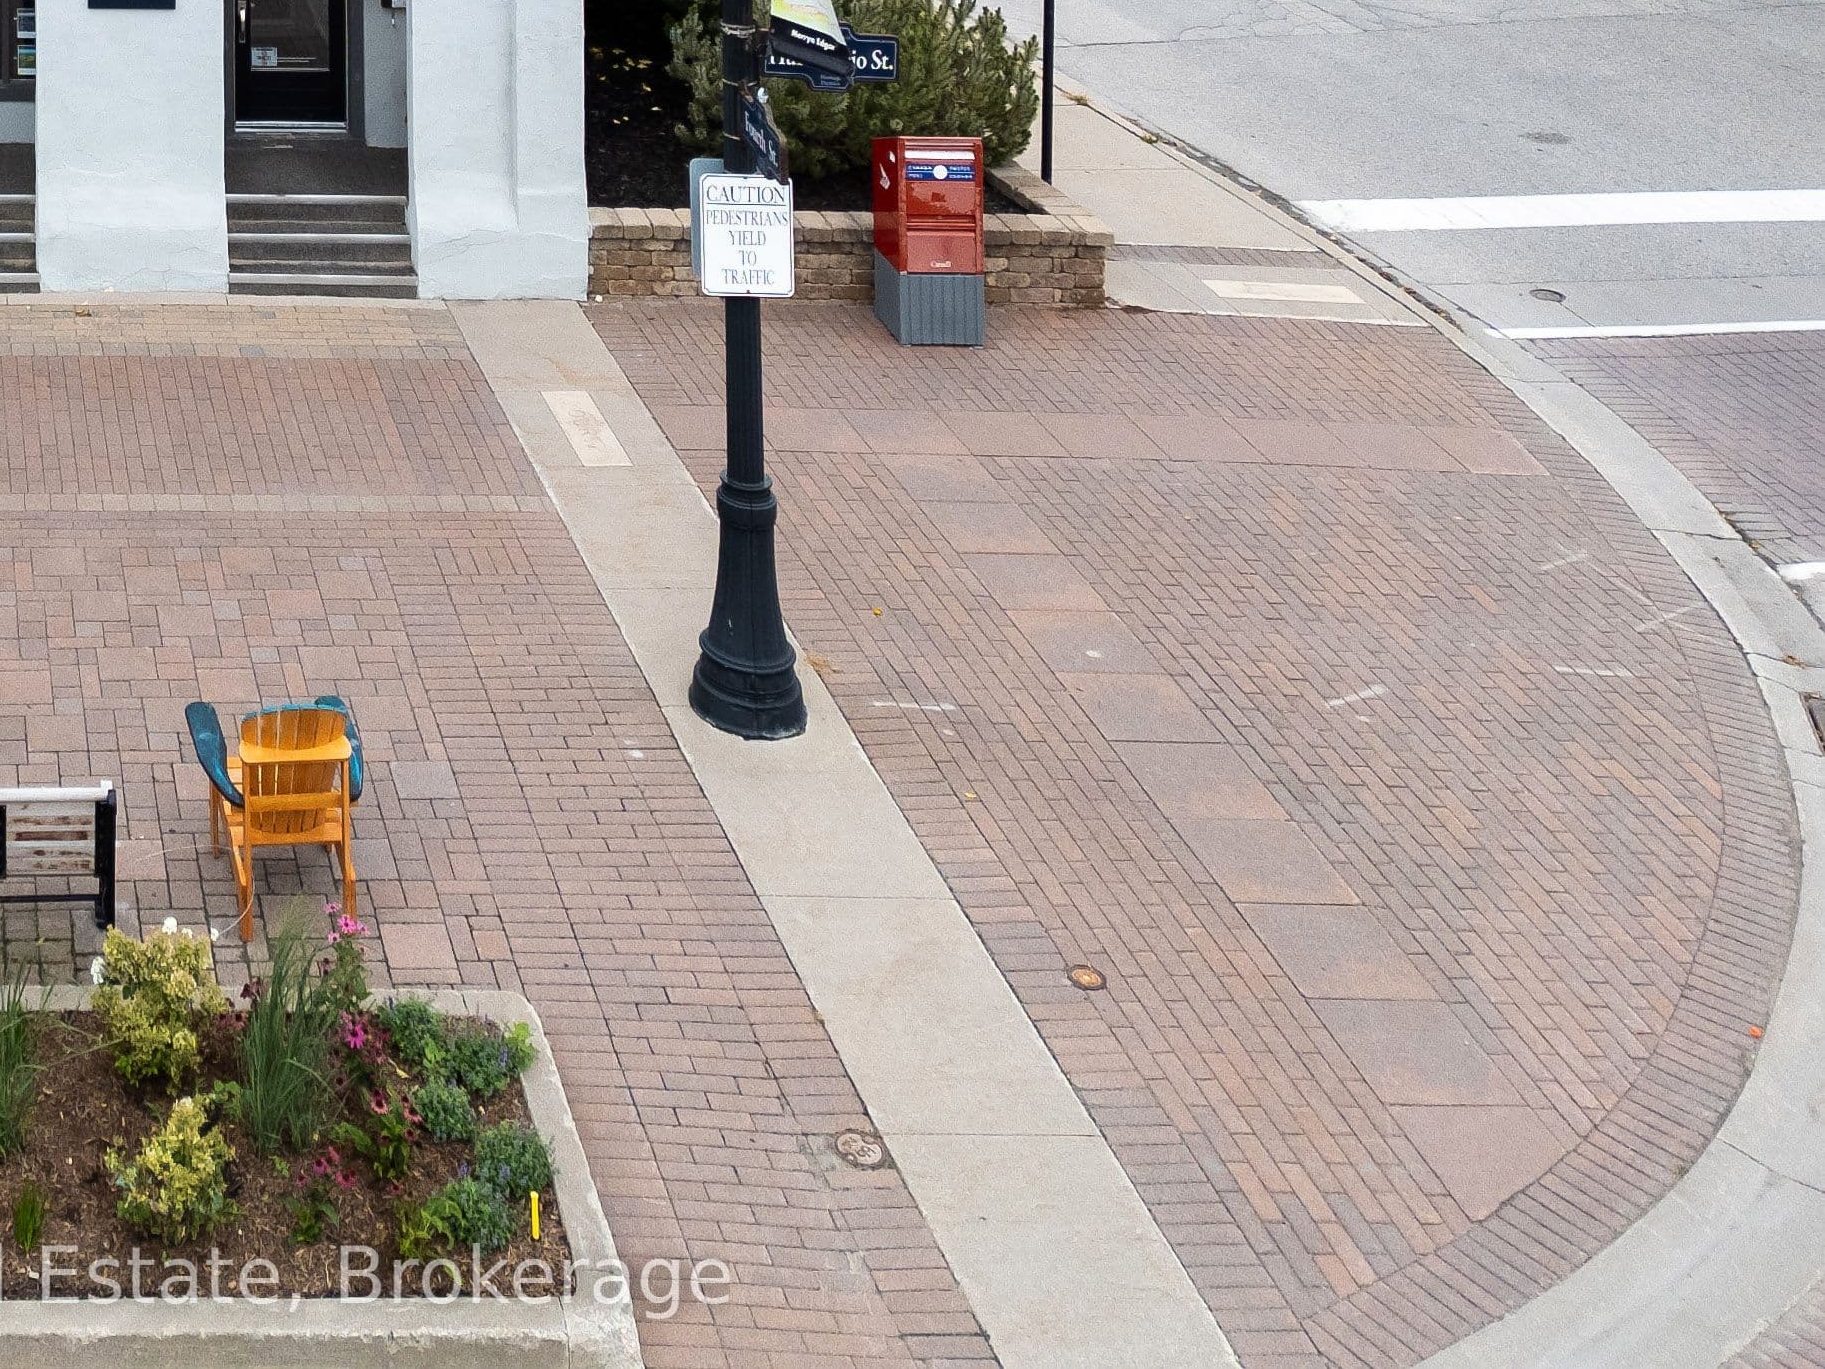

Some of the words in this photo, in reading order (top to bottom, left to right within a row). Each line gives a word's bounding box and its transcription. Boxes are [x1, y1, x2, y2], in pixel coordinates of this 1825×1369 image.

[870, 49, 894, 71] St.
[744, 111, 767, 155] Fourth
[706, 185, 785, 204] CAUTION
[706, 209, 789, 226] PEDESTRIANS
[728, 230, 767, 246] YIELD
[738, 250, 757, 267] TO
[721, 268, 775, 286] TRAFFIC
